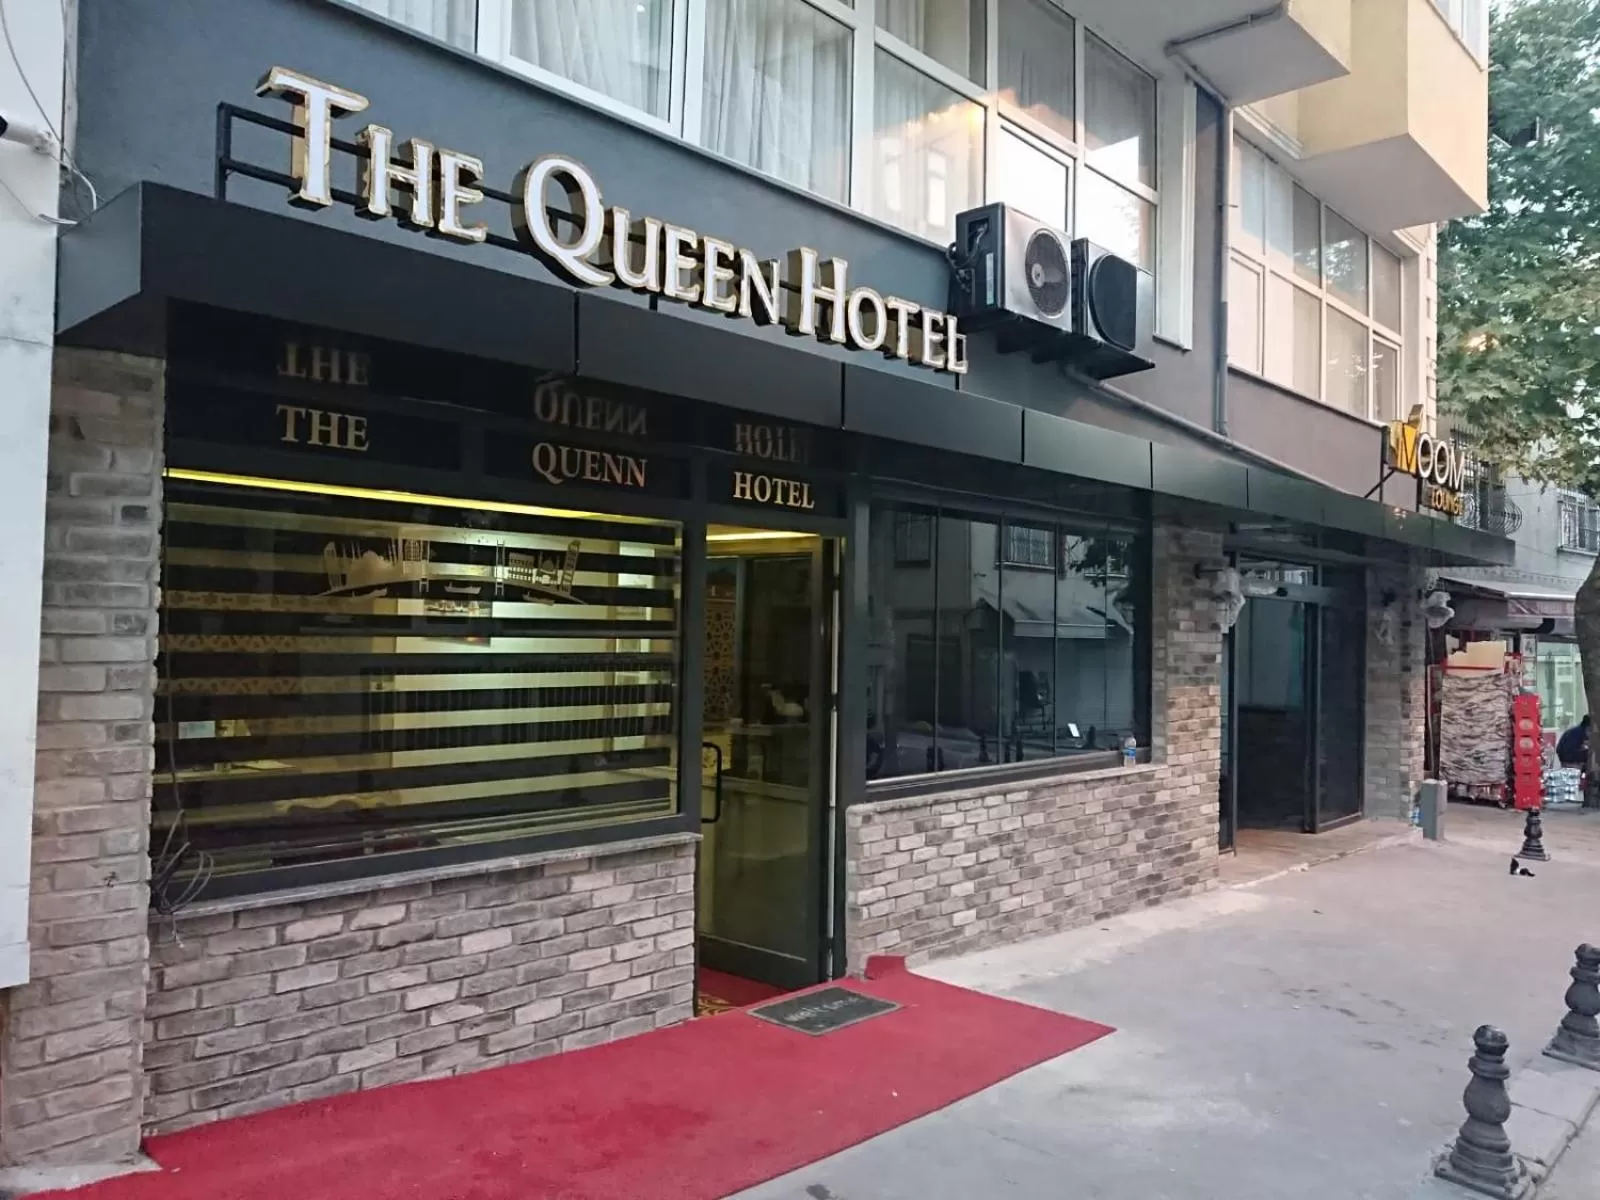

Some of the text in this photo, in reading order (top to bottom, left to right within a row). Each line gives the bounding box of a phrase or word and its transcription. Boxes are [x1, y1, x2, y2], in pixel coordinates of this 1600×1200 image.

[256, 66, 969, 374] THE QUEEN HOTEL
[275, 403, 816, 511] THE QUENN HOTEL
